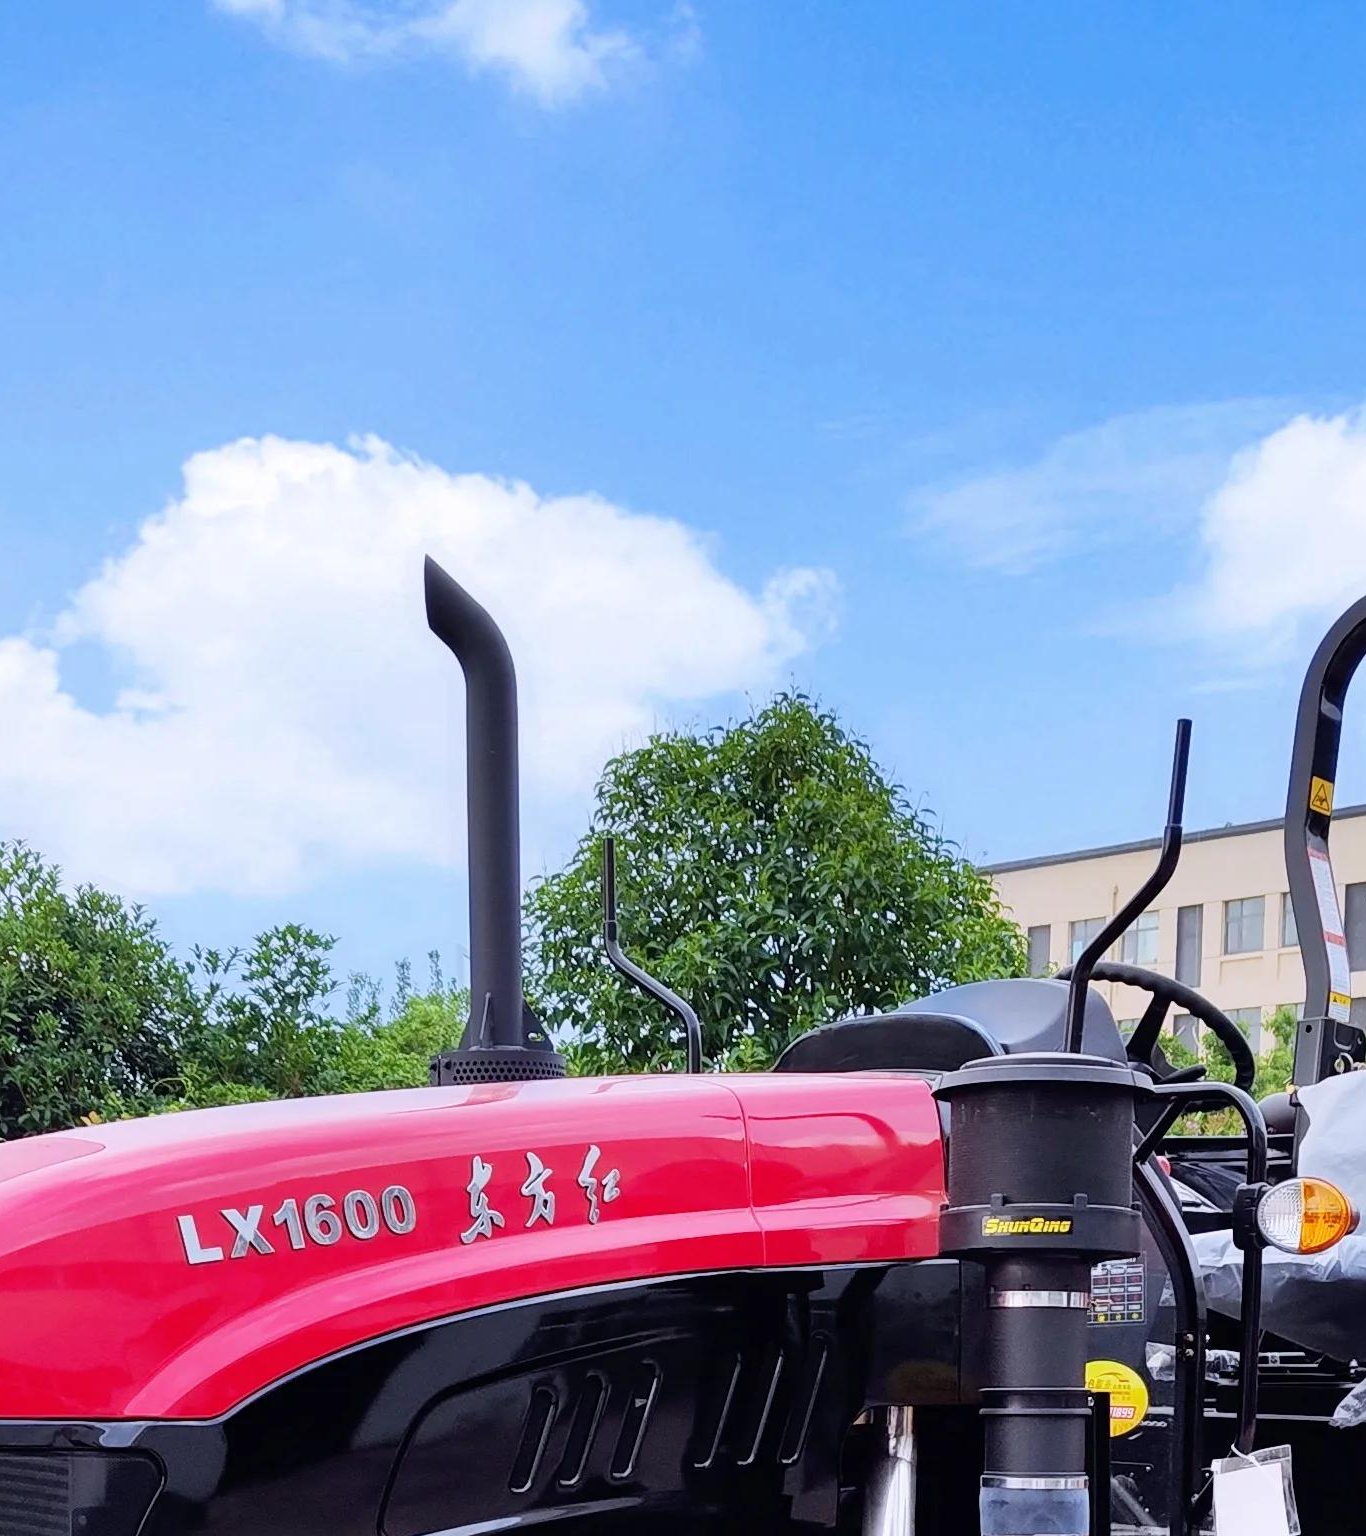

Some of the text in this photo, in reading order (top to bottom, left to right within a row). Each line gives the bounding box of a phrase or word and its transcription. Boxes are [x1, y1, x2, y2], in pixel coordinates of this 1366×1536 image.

[176, 1185, 418, 1266] LX1600
[459, 1144, 620, 1246] 东方红
